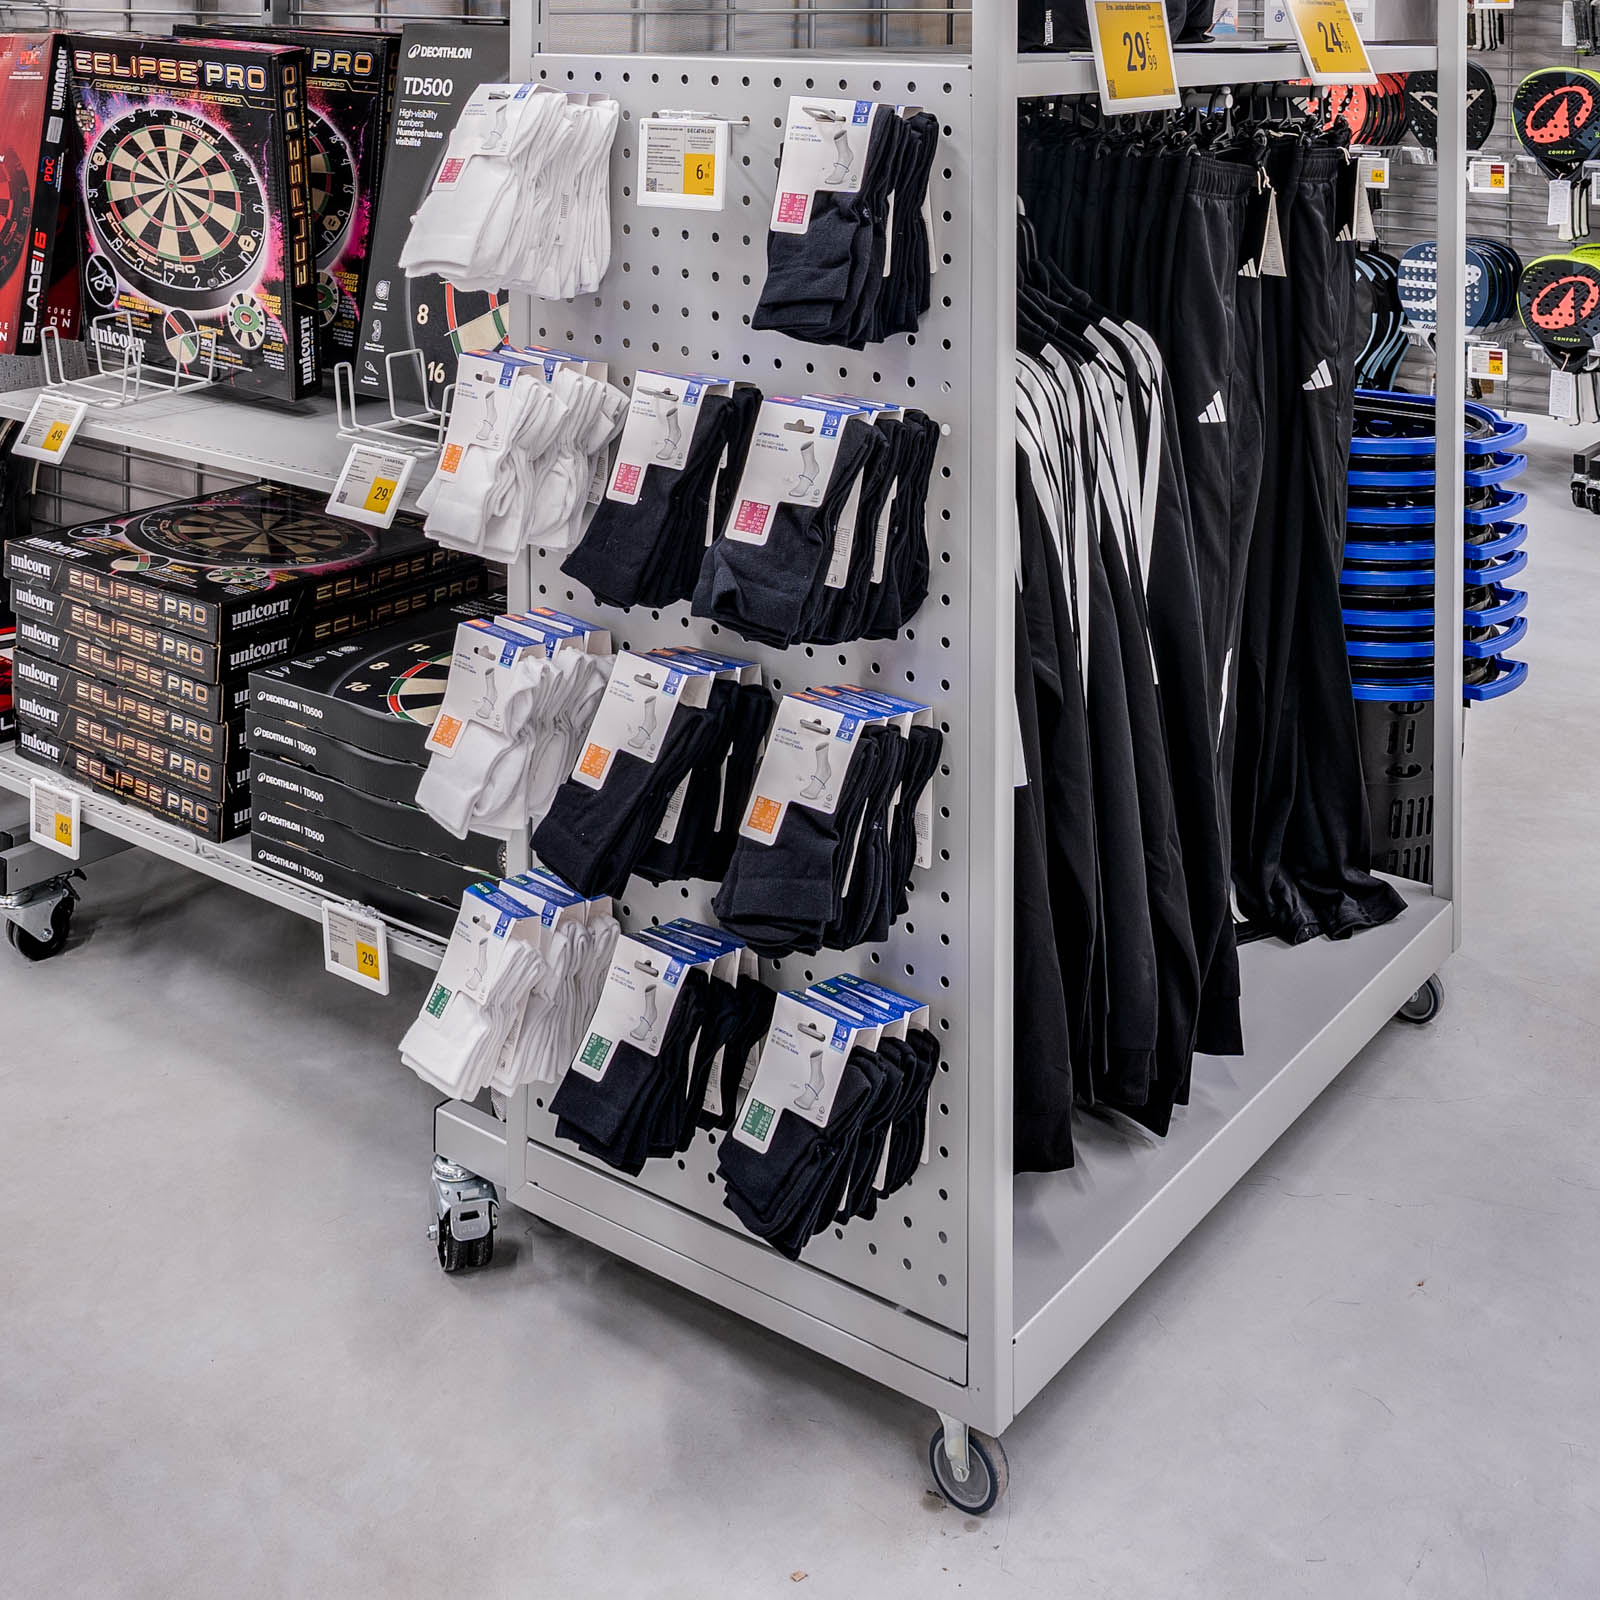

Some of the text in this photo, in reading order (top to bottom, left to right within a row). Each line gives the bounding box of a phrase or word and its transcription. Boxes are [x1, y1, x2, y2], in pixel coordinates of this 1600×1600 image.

[1317, 21, 1342, 53] 24
[311, 49, 375, 75] PRO
[420, 47, 473, 59] DECATHLON
[1123, 32, 1146, 71] 29
[73, 49, 267, 93] ECLIPSE PRO
[282, 64, 300, 132] PRO
[403, 75, 453, 97] TD500
[397, 118, 425, 129] numbers
[399, 108, 438, 121] High-visibility
[170, 117, 219, 146] unicorn
[395, 136, 421, 147] visibilité
[396, 128, 443, 139] Numéros haute
[162, 259, 196, 275] PRO
[416, 303, 429, 326] 8
[299, 314, 313, 386] unicorn
[427, 361, 446, 383] 16
[10, 553, 52, 574] unicorn
[15, 588, 55, 609] unicorn
[69, 568, 208, 625] ECLIPSE PRO
[434, 575, 480, 602] PRO
[231, 599, 291, 625] unicorn
[21, 623, 60, 646] unicorn
[71, 605, 204, 665] ECLIPSE PRO
[230, 638, 289, 665] unicorn
[18, 662, 59, 684] unicorn
[77, 641, 209, 704] ECLIPSE PRO
[19, 697, 59, 722] unicorn
[77, 680, 214, 744] ECLIPSE PRO
[265, 692, 323, 719] DECATHLON TD500
[21, 732, 60, 758] unicorn
[76, 717, 212, 784] ECLIPSE PRO
[263, 729, 317, 756] DECATHLON TD500
[76, 753, 209, 824] ECLIPSE PRO
[266, 774, 324, 803] DECATHLON TD500
[267, 813, 325, 843] DECATHLON TD500
[266, 852, 324, 882] DECATHLON TD500
